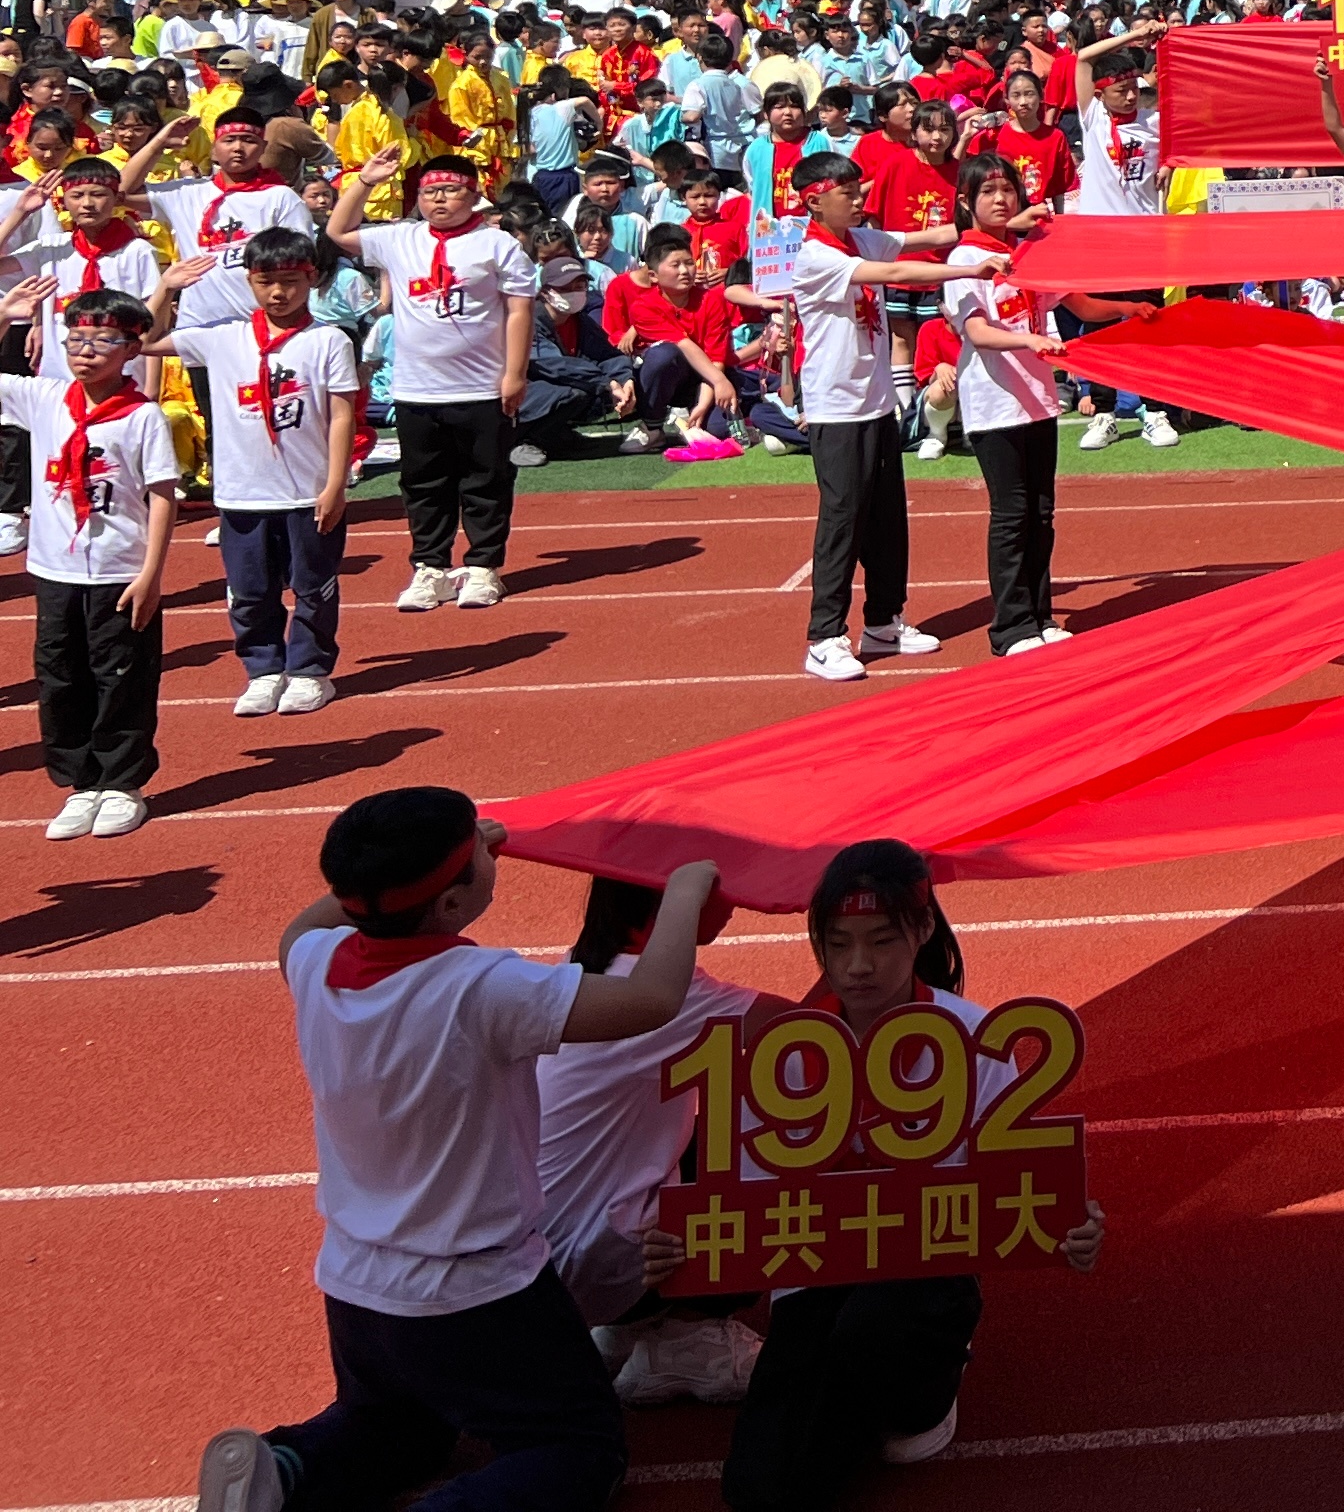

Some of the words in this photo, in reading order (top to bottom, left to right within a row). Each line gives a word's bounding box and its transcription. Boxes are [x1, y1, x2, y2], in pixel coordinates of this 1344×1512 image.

[670, 1004, 1076, 1172] 1992
[686, 1172, 1058, 1282] 中共十四大
